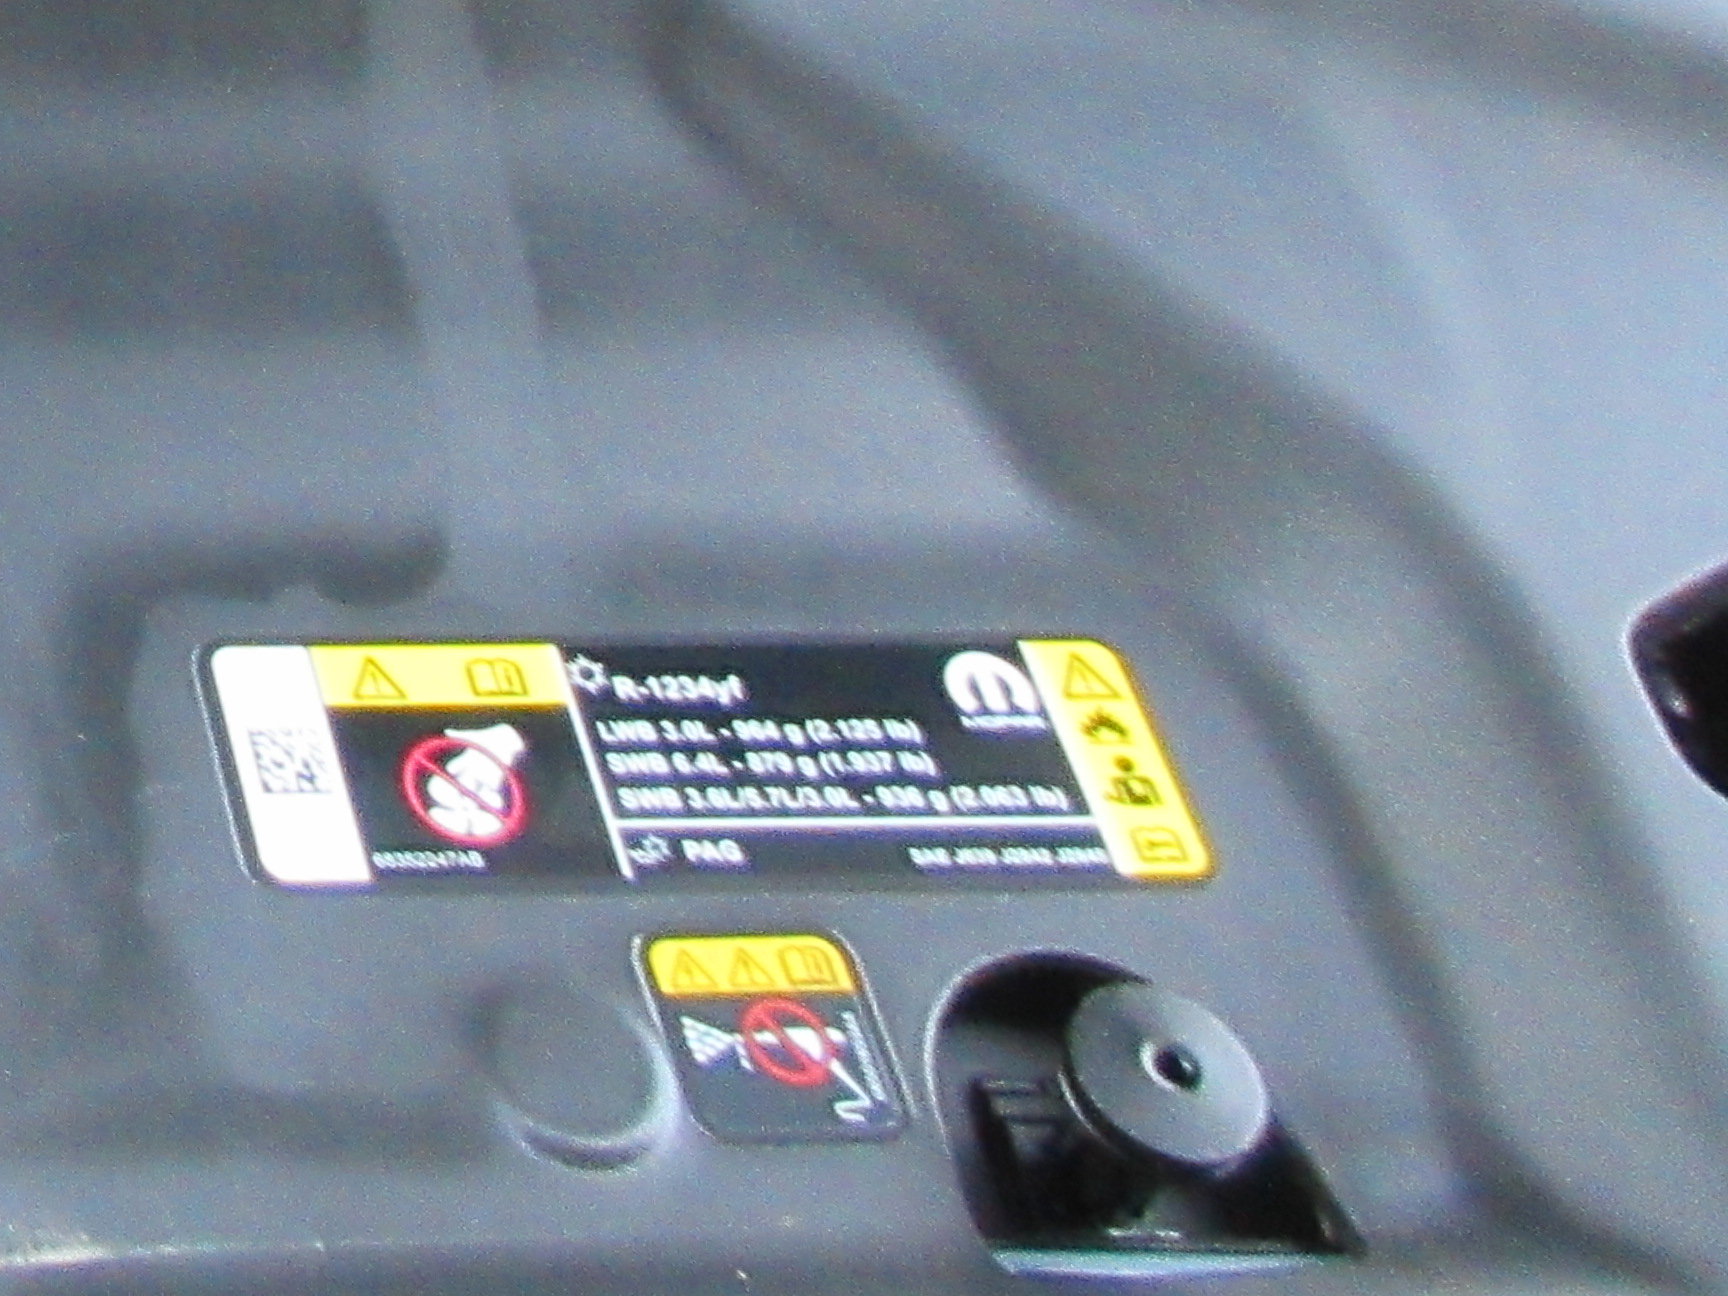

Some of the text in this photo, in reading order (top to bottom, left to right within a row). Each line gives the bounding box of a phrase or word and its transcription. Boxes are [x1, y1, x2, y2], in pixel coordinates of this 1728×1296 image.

[610, 673, 745, 707] R-1234yf
[595, 719, 659, 743] LWB
[658, 719, 718, 743] 3.0L
[604, 751, 671, 775] SWB
[670, 751, 731, 775] 6.4L
[616, 785, 684, 809] SWB
[680, 838, 745, 863] PAG
